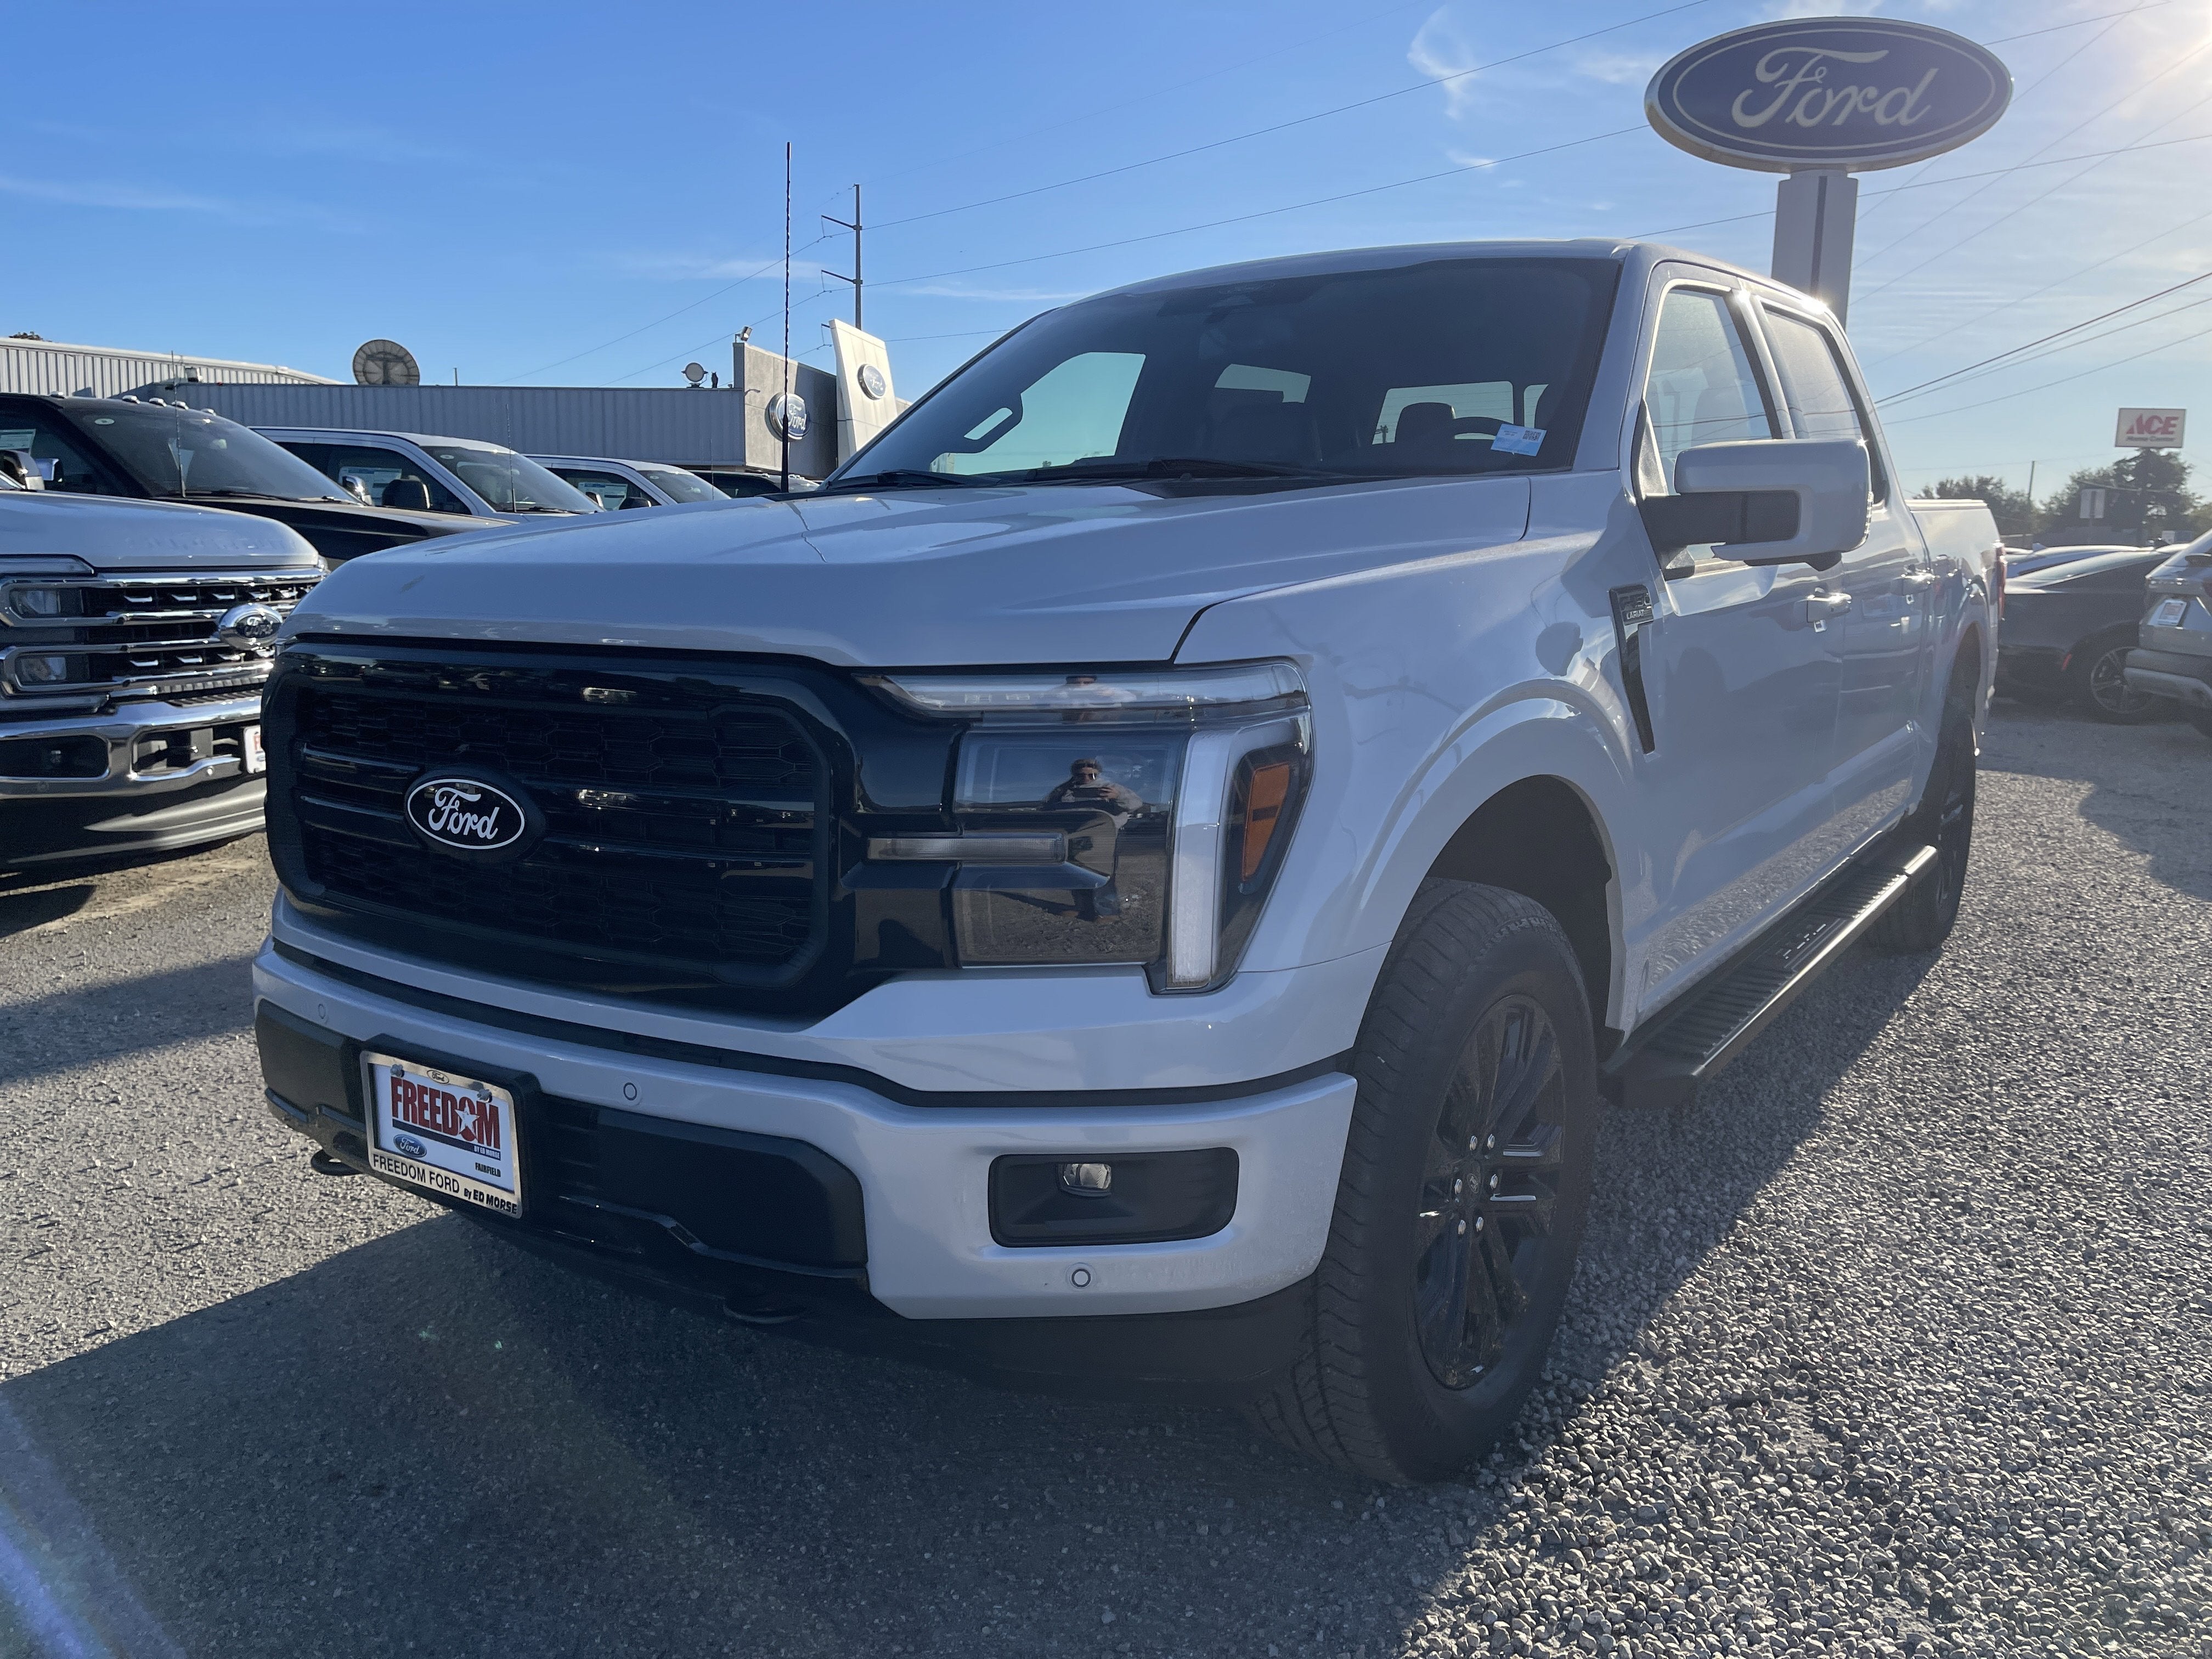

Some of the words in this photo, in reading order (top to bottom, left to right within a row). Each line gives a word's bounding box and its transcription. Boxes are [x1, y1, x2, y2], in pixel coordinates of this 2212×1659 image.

[1731, 47, 1939, 128] Ford
[787, 403, 807, 431] Ford
[2126, 413, 2179, 435] ACE
[1627, 610, 1644, 619] LARIAT
[428, 787, 500, 839] Ford
[432, 1070, 445, 1082] Ford
[391, 1076, 500, 1150] FREEDOM
[399, 1137, 420, 1154] Ford
[475, 1162, 501, 1177] FAIRFIELD
[373, 1154, 426, 1183] FREEDOM
[429, 1172, 460, 1193] FORD
[473, 1189, 484, 1203] ED
[486, 1194, 517, 1214] MORSE
